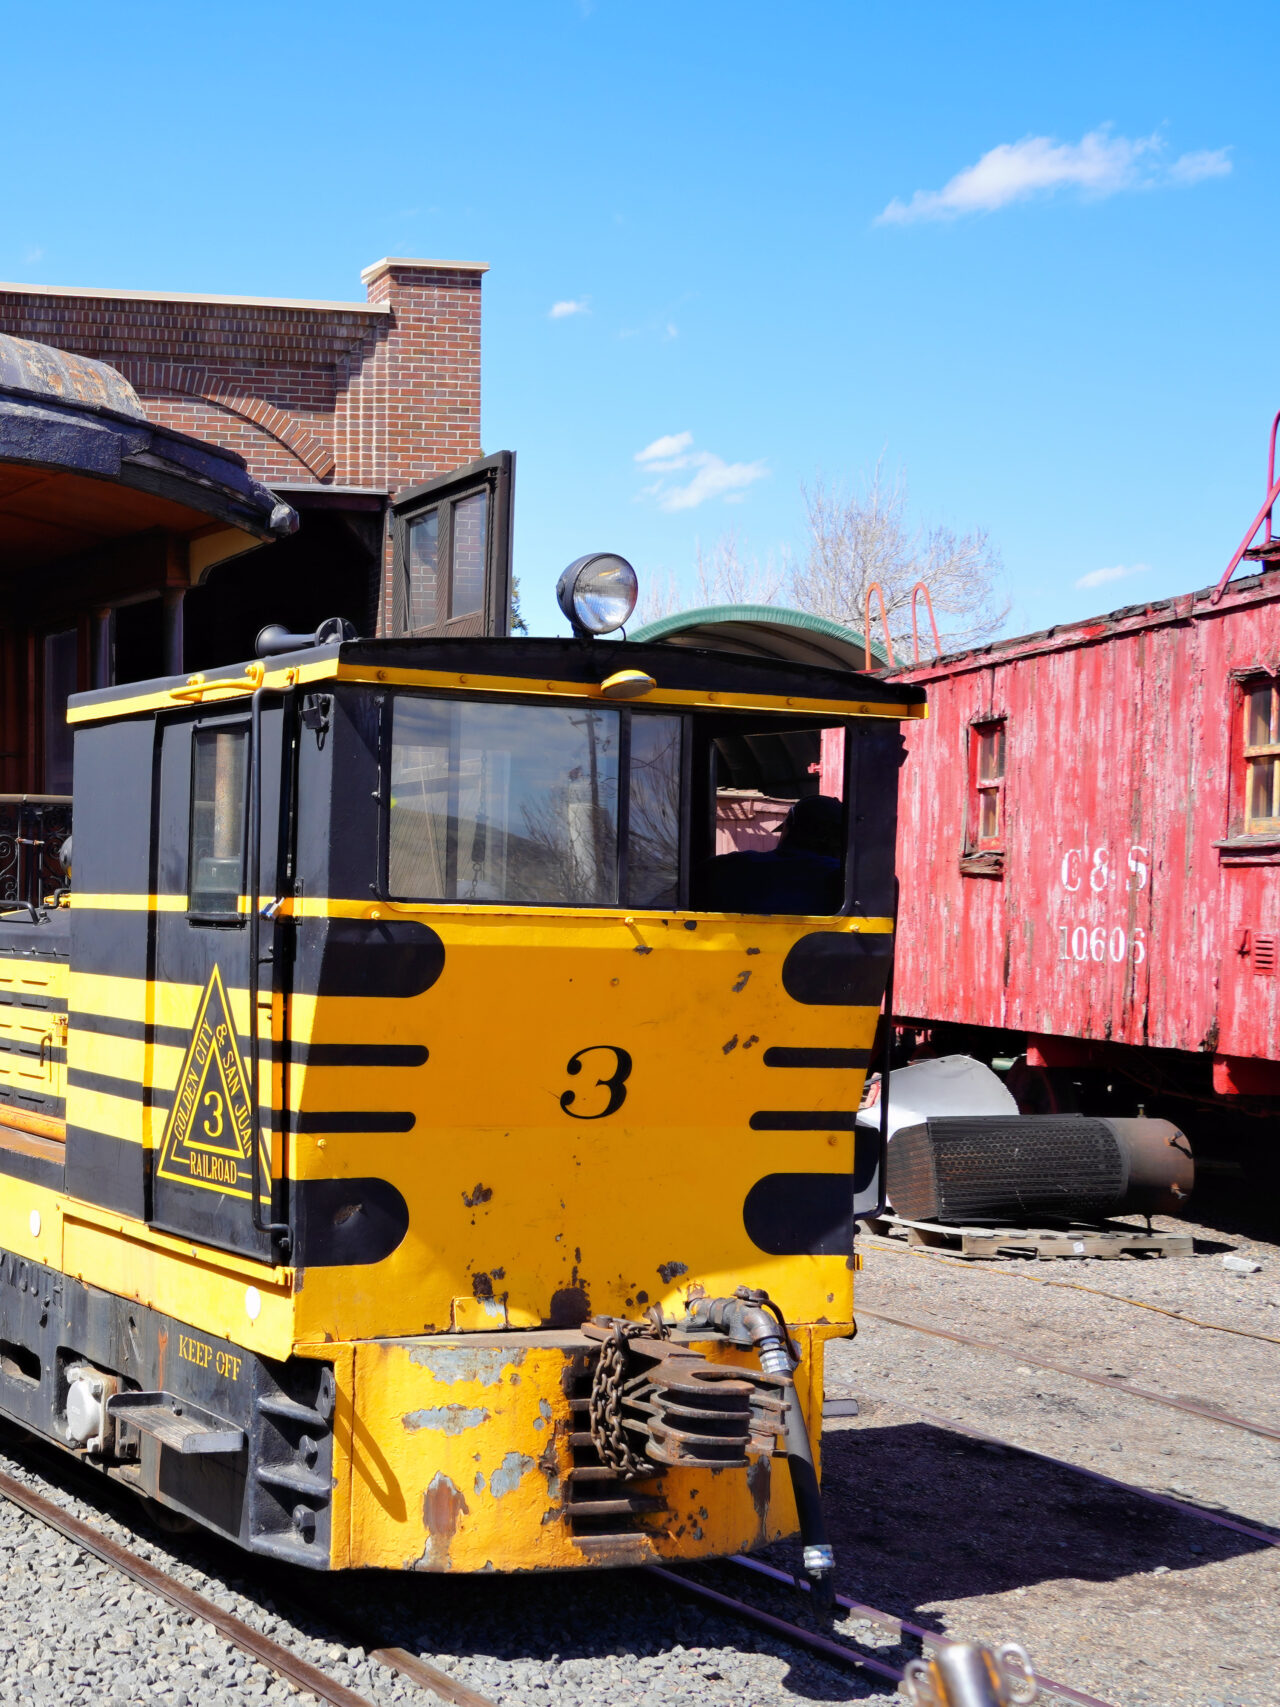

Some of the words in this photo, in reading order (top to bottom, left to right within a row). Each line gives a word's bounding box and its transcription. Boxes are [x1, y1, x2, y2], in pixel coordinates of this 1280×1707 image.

[1061, 848, 1082, 892] C
[1126, 845, 1150, 892] S
[174, 1067, 200, 1140] GOLDEN
[195, 1017, 215, 1066] CITY
[215, 1023, 228, 1048] &
[222, 1050, 241, 1096] SAN
[560, 1045, 632, 1120] 3
[203, 1090, 224, 1138] 3
[190, 1151, 237, 1185] RAILROAD
[178, 1334, 213, 1369] KEEP
[215, 1351, 242, 1381] OFF
